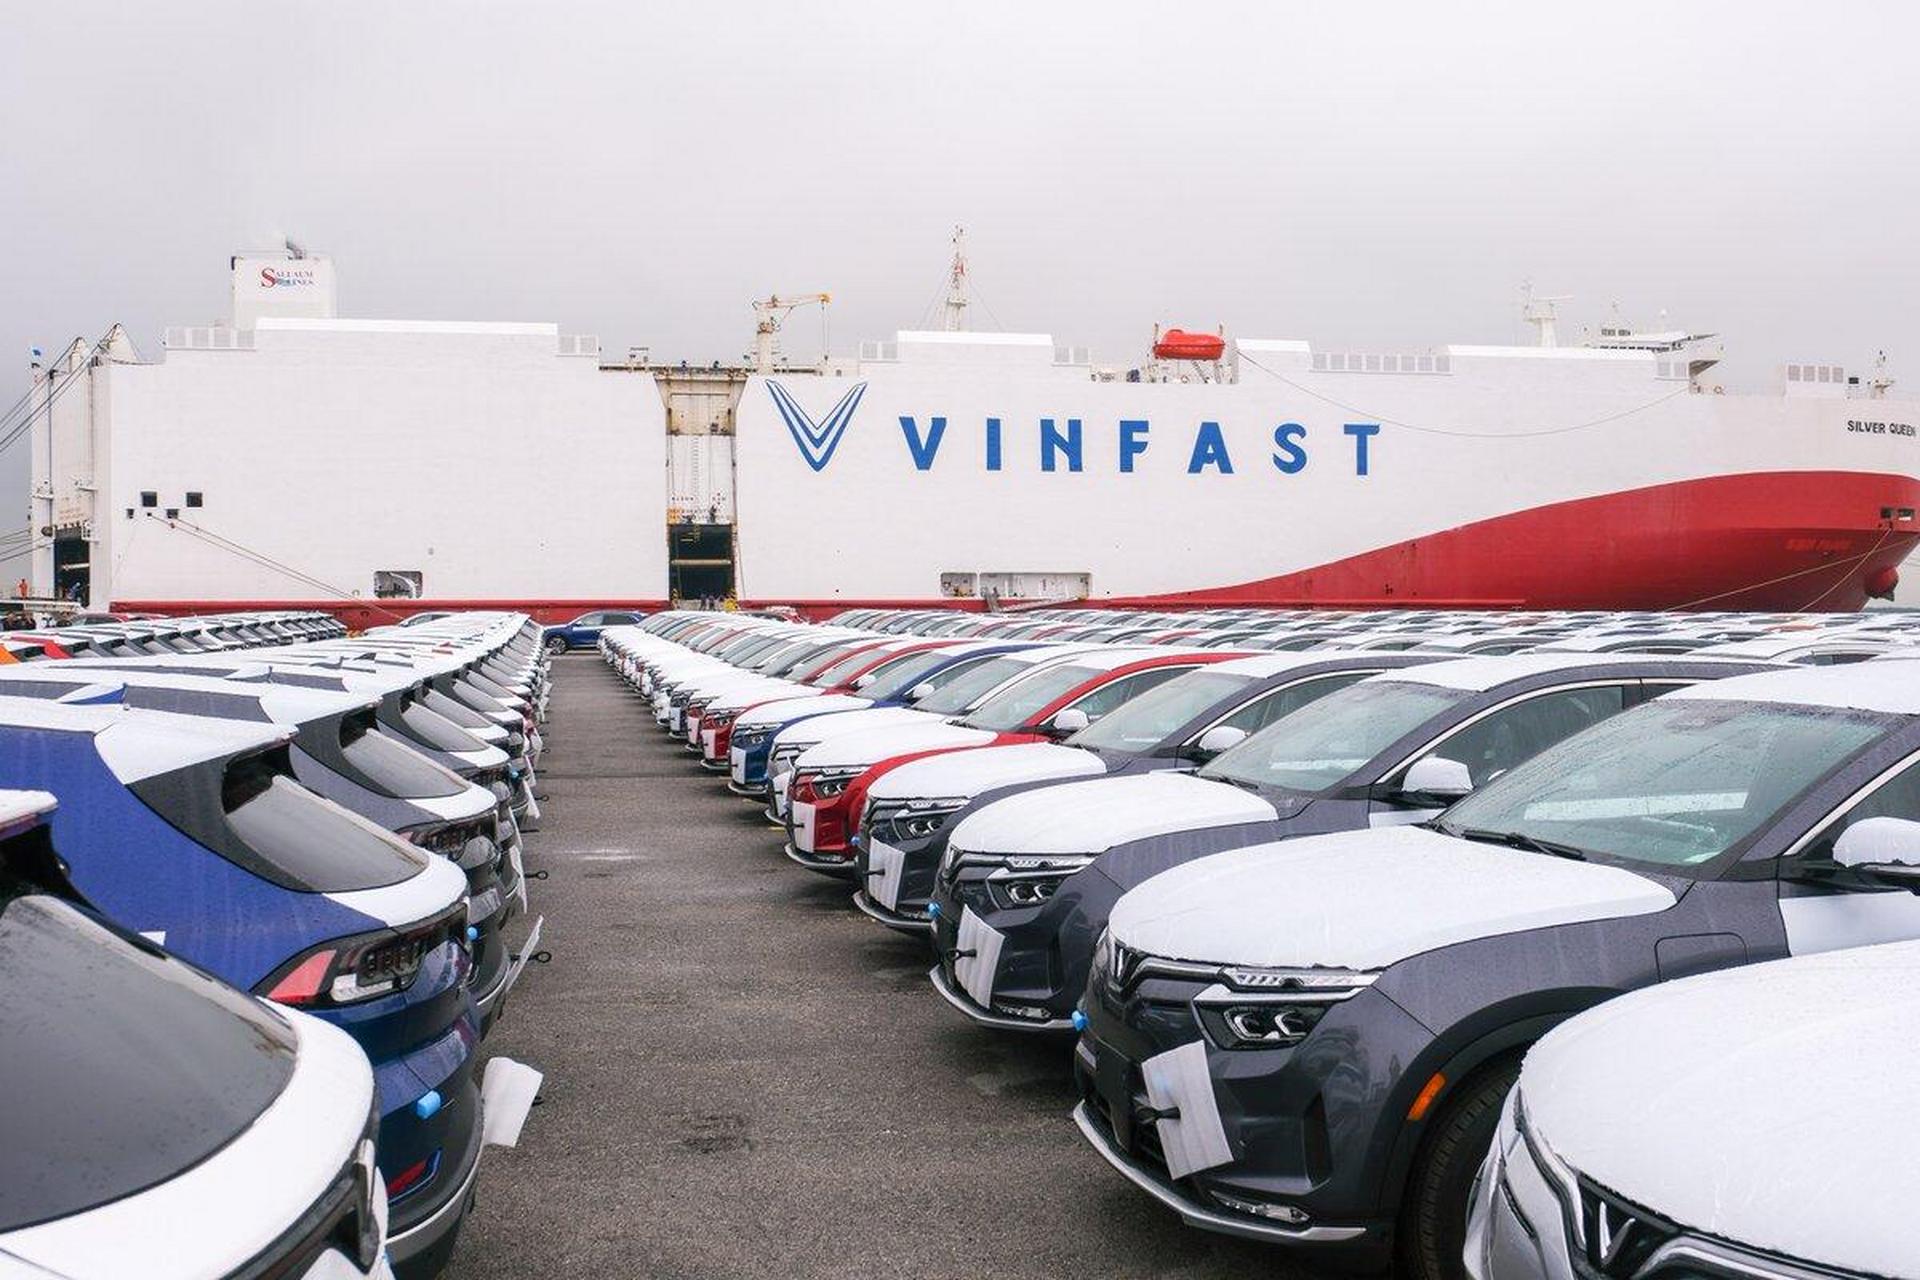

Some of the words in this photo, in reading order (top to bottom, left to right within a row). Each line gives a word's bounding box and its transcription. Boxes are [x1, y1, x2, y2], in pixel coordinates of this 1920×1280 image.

[898, 416, 1381, 476] VINFAST
[1847, 420, 1886, 434] SILVER
[1888, 423, 1917, 437] QUEEN
